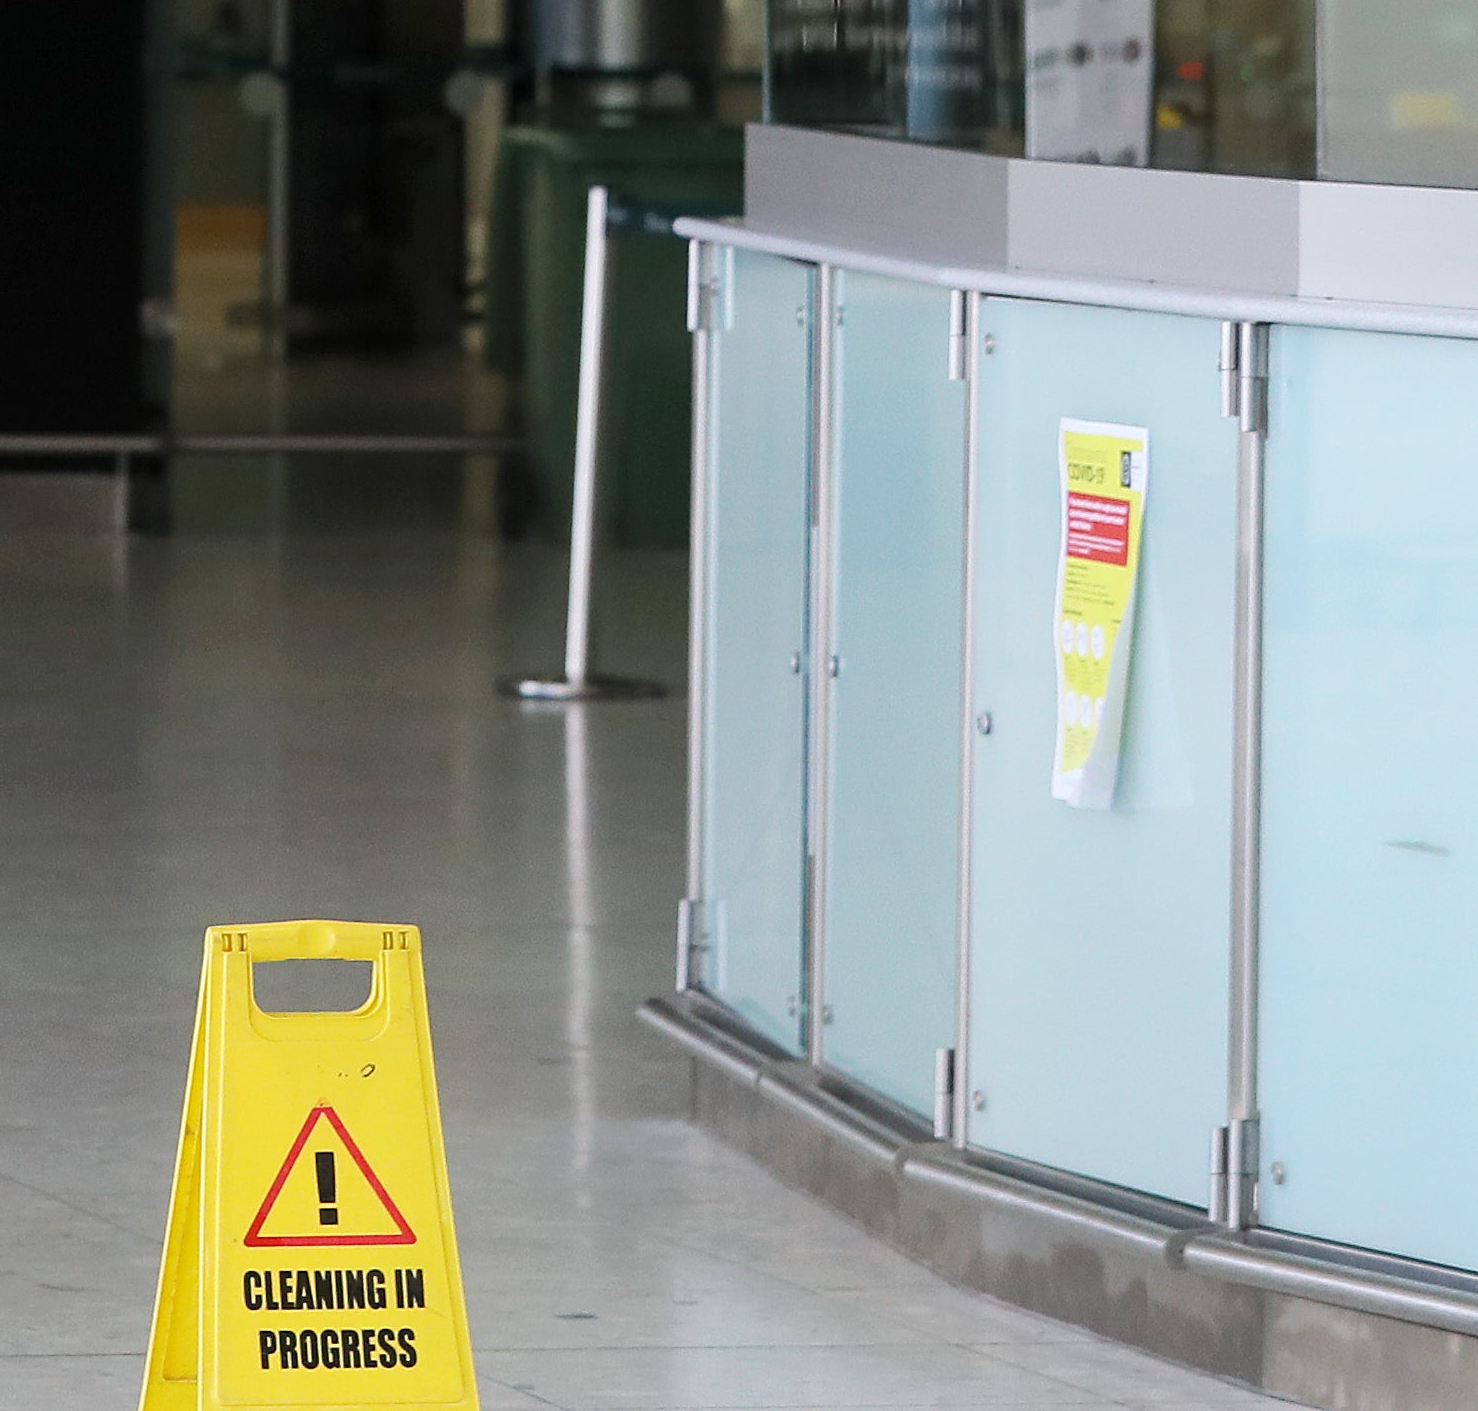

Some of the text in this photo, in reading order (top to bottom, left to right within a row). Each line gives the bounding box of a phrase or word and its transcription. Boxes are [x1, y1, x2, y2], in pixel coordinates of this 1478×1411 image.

[243, 1267, 427, 1312] CLEANING IN
[258, 1327, 419, 1371] PROGRESS
